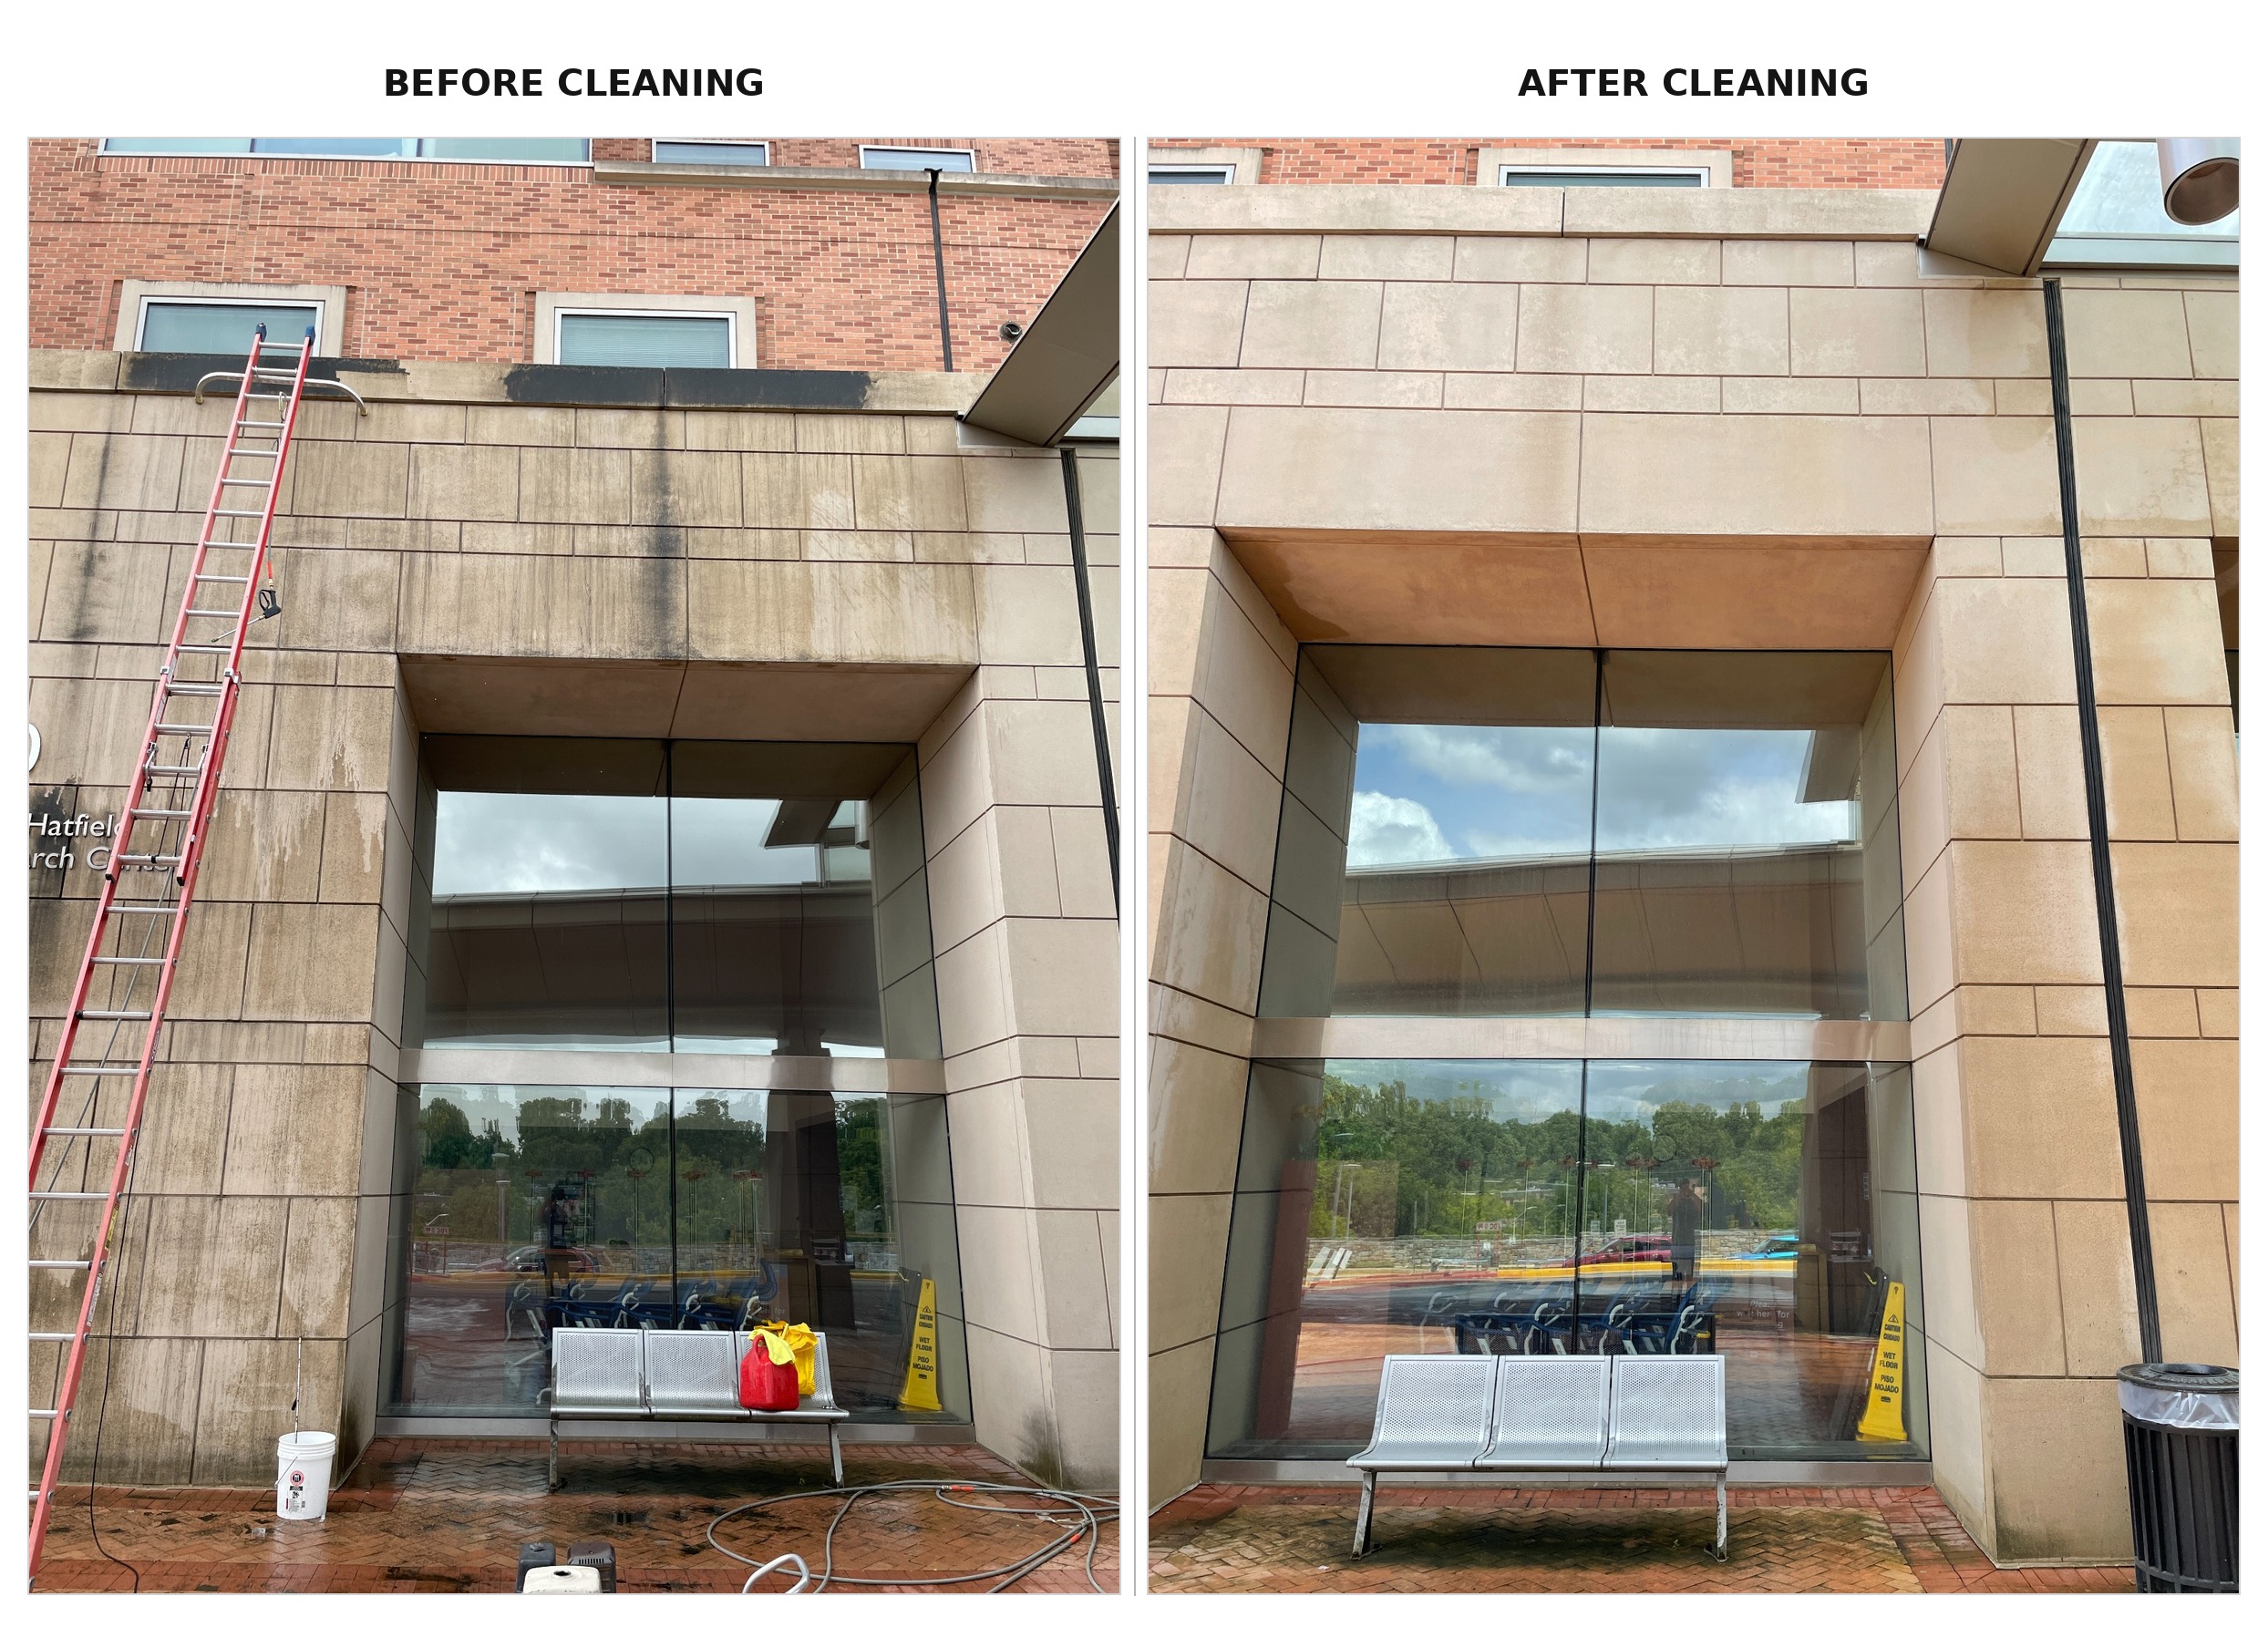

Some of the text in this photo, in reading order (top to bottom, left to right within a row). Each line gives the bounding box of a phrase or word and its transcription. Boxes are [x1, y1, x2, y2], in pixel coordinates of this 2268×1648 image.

[28, 846, 75, 870] rch
[916, 1344, 933, 1352] FLOOR
[917, 1355, 930, 1364] PISO
[1883, 1351, 1896, 1360] WET
[912, 1363, 934, 1372] MOJADO
[1879, 1359, 1898, 1369] FLOOR
[1881, 1375, 1894, 1384] PISO
[1874, 1383, 1899, 1394] MOJADO
